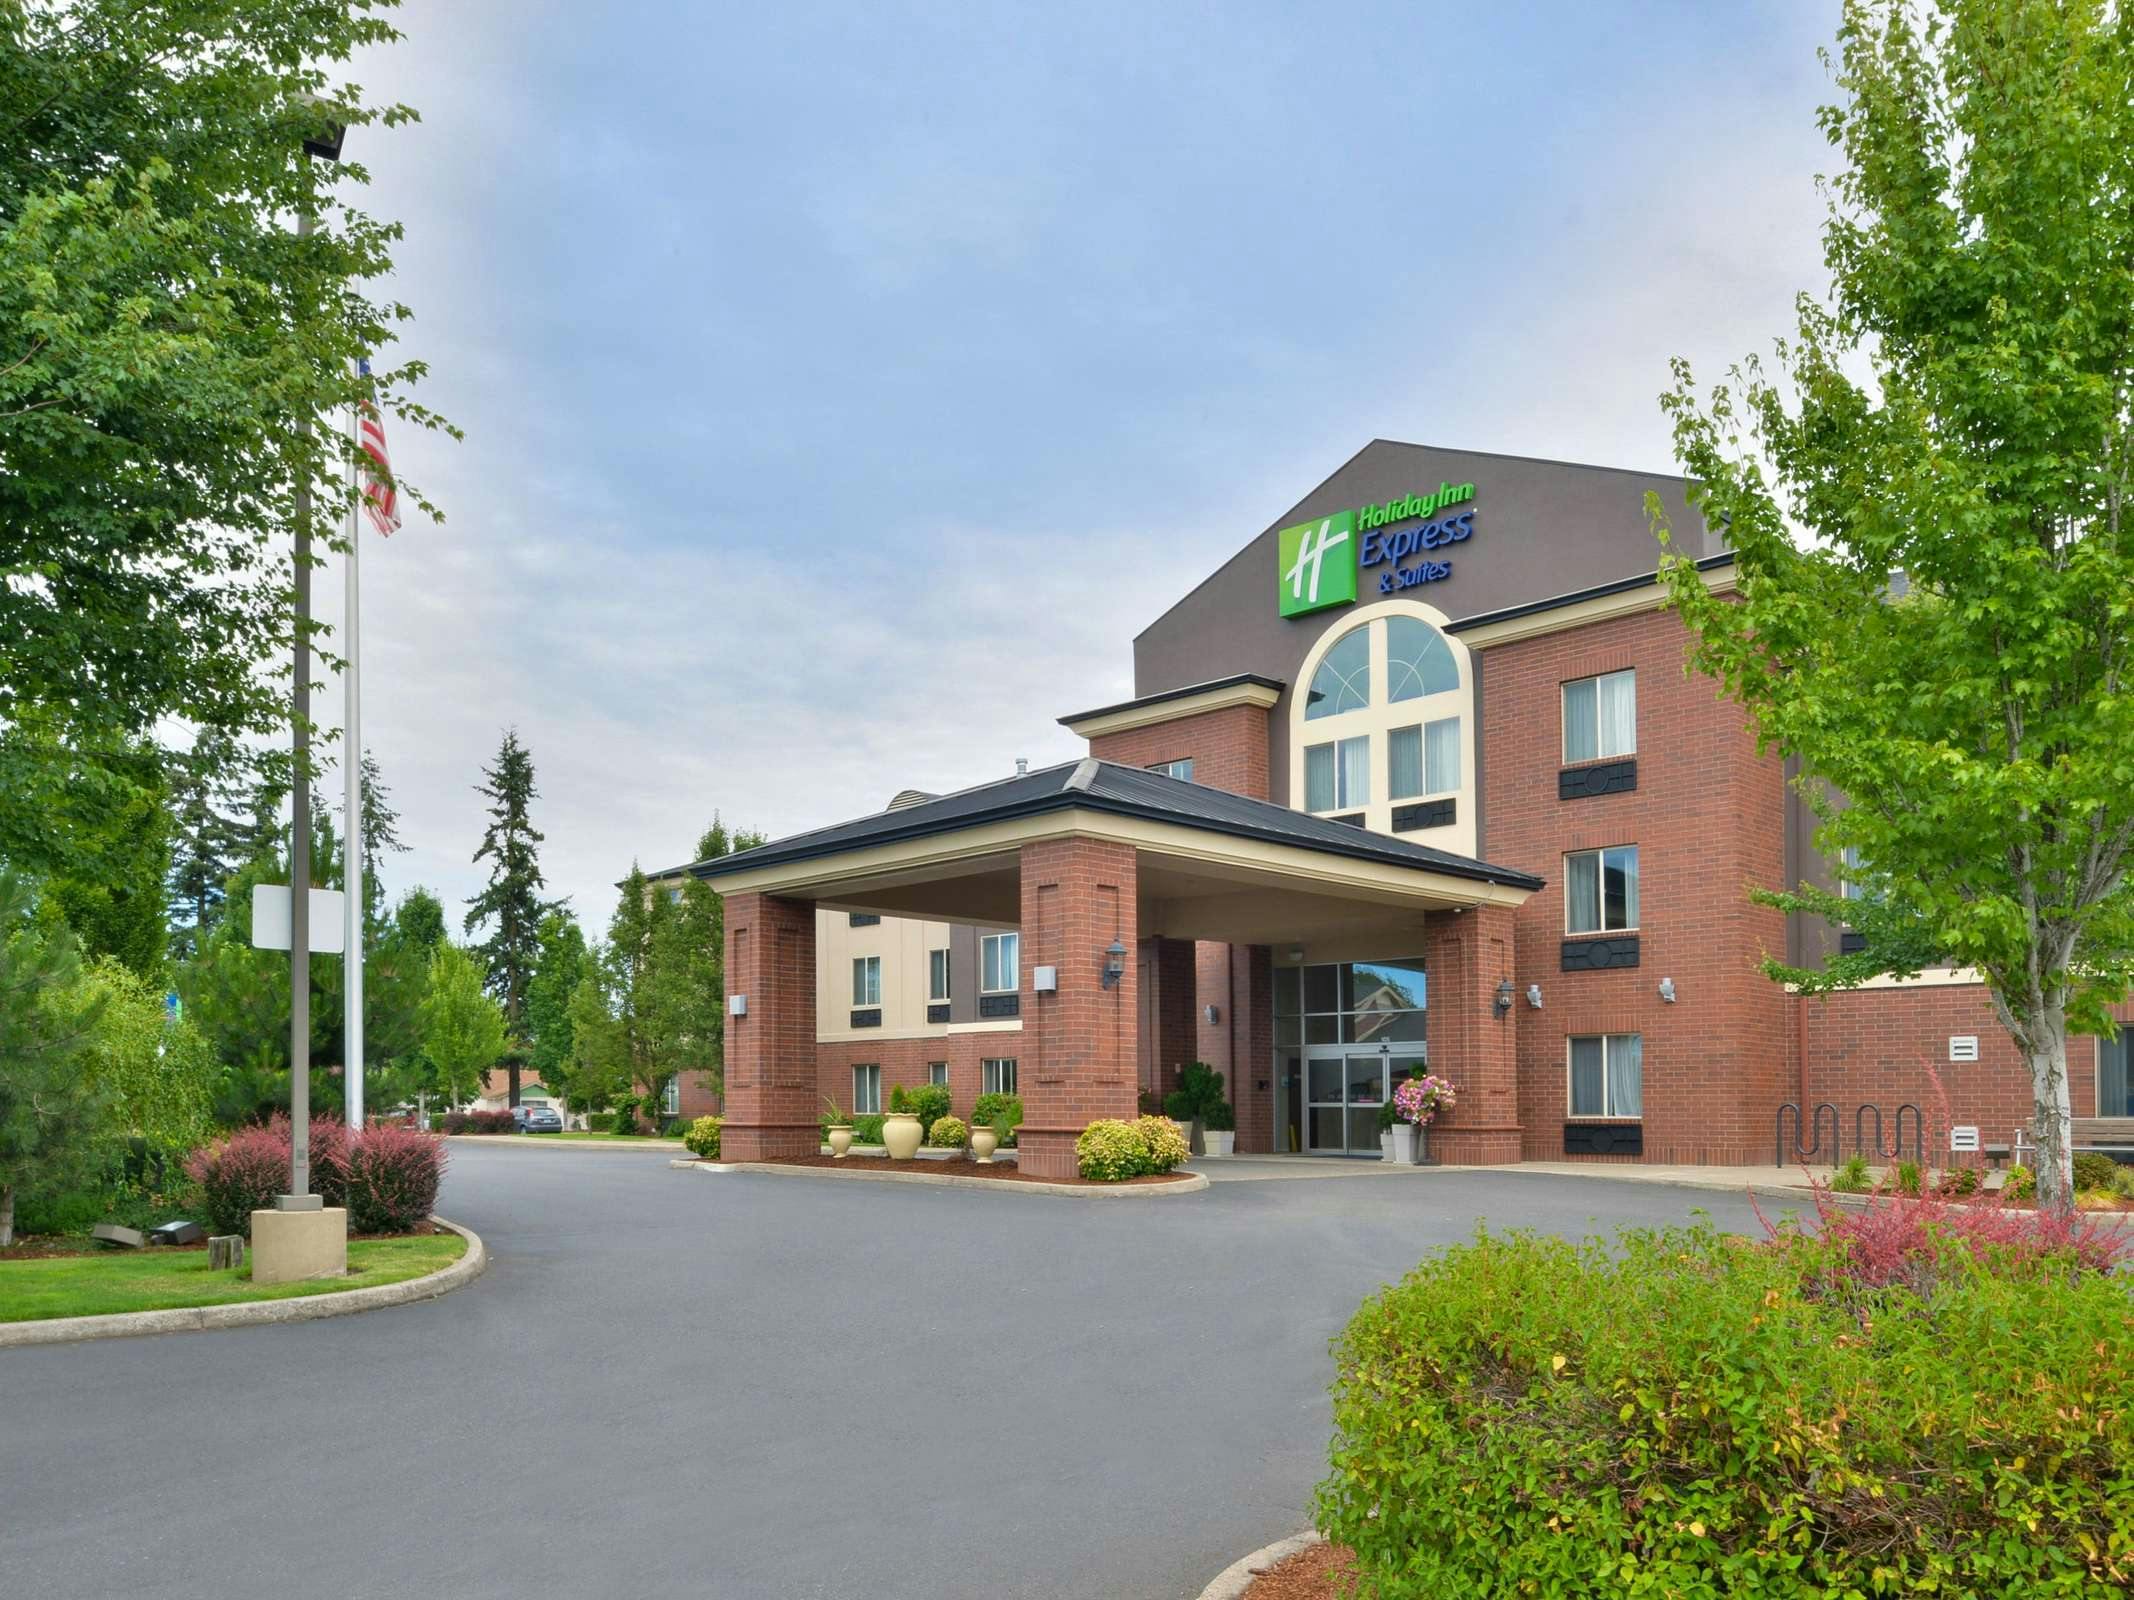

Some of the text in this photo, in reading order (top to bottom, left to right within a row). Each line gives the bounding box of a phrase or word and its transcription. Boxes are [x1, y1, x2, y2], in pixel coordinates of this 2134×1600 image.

[1358, 481, 1475, 531] Holiday Inn
[1360, 511, 1474, 568] Express
[1378, 559, 1451, 593] & Suites
